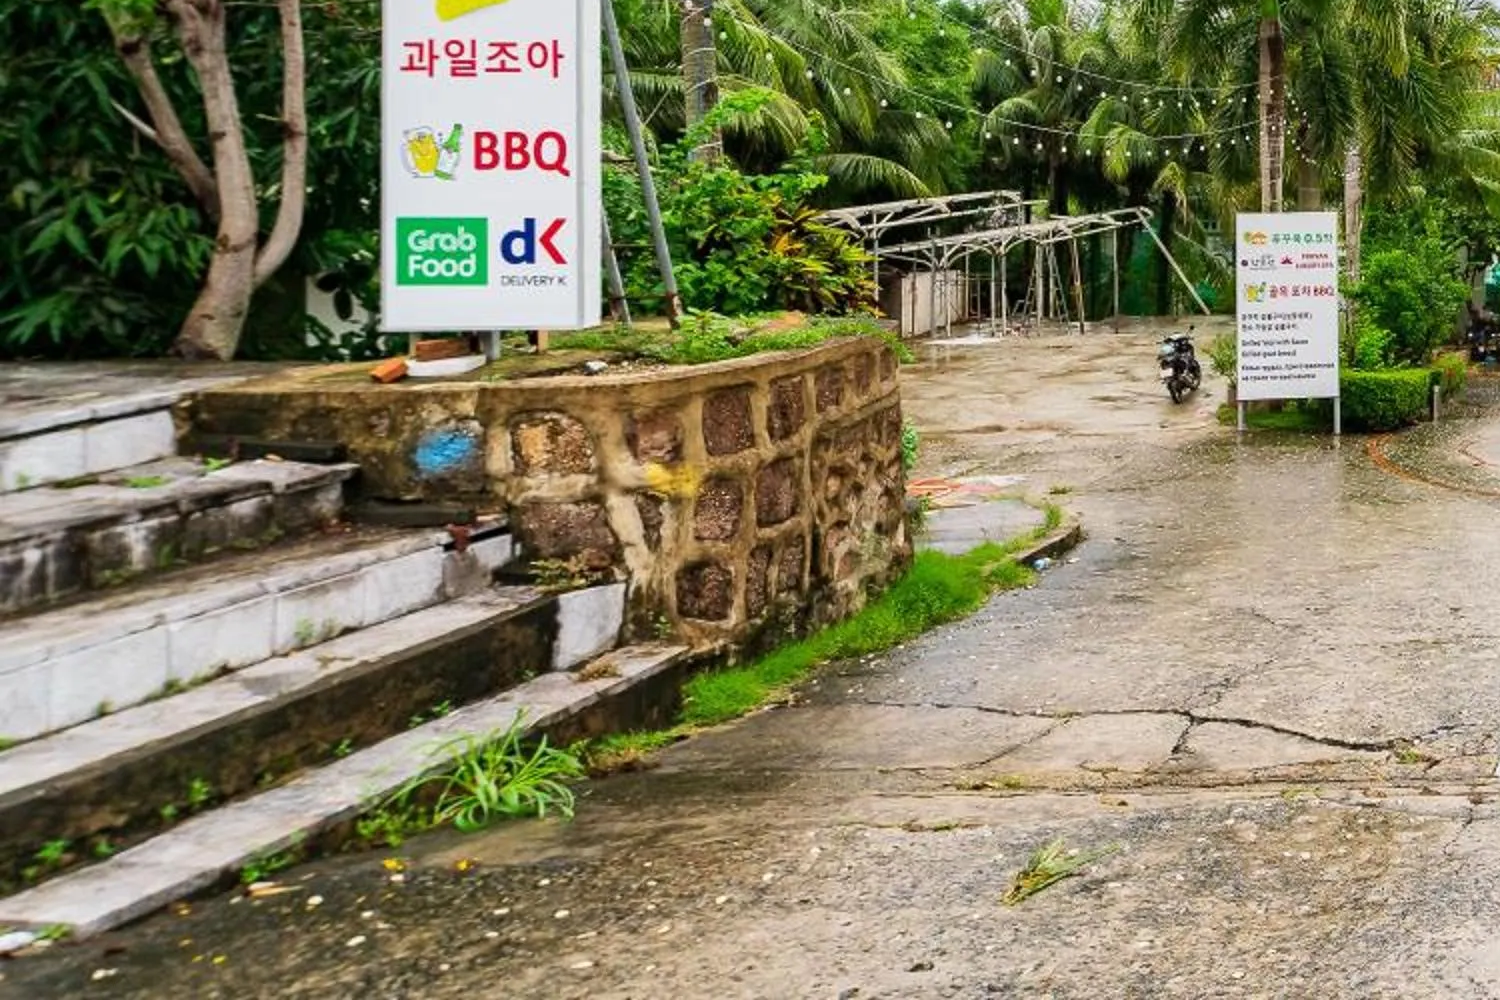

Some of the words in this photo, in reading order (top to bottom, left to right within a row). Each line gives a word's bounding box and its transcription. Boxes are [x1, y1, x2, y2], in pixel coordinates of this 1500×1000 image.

[400, 38, 565, 78] 과일조아
[473, 130, 571, 177] BBQ
[407, 225, 477, 252] Grab
[408, 254, 477, 278] Food
[500, 275, 554, 286] DELIVERY
[557, 275, 567, 286] K
